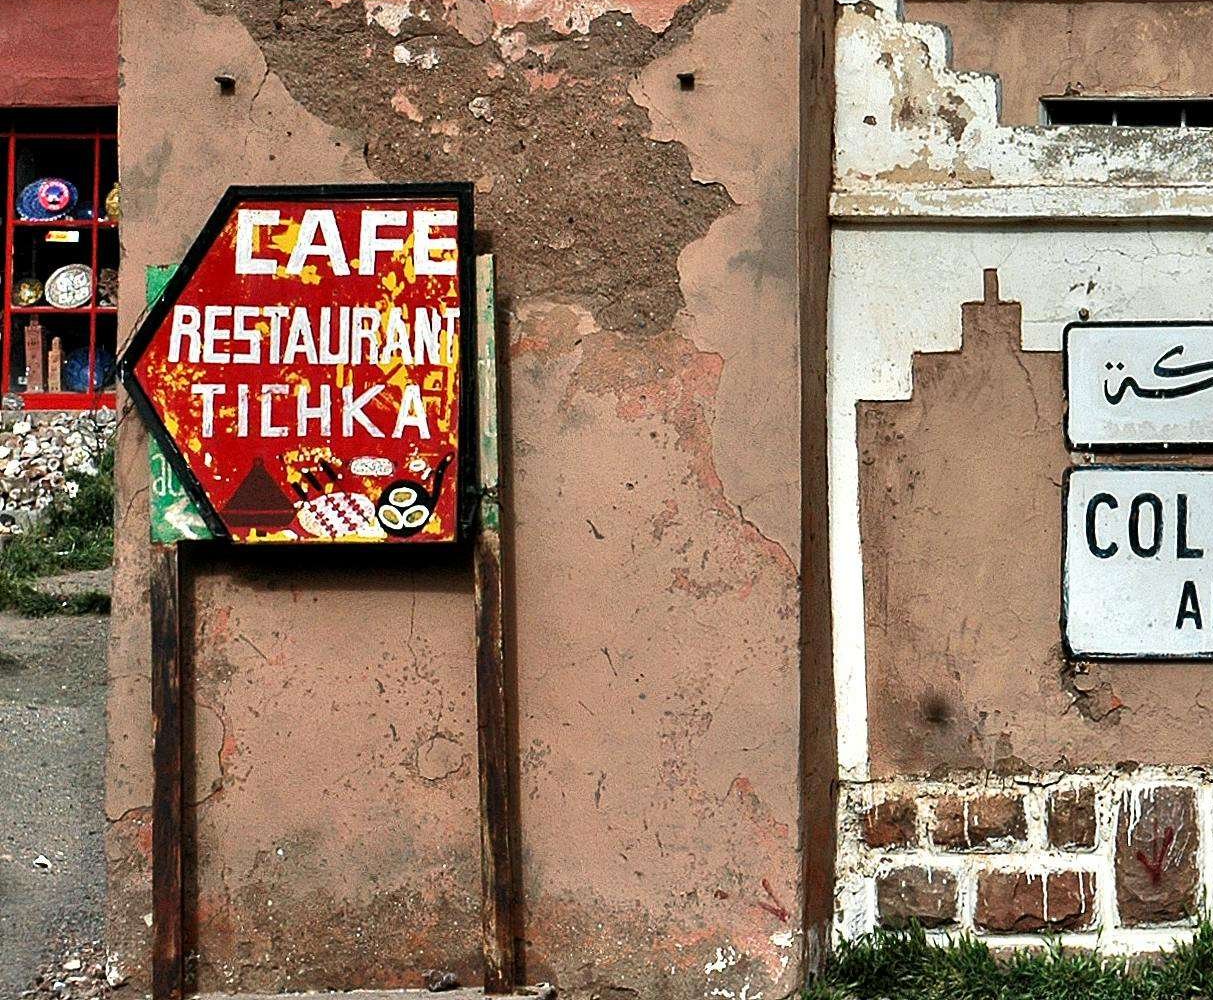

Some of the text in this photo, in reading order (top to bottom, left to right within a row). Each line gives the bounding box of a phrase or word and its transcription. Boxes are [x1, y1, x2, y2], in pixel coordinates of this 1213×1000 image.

[234, 209, 459, 276] CAFE
[167, 305, 461, 365] RESTAURANT
[190, 383, 432, 440] TICHKA
[1085, 492, 1204, 559] COL
